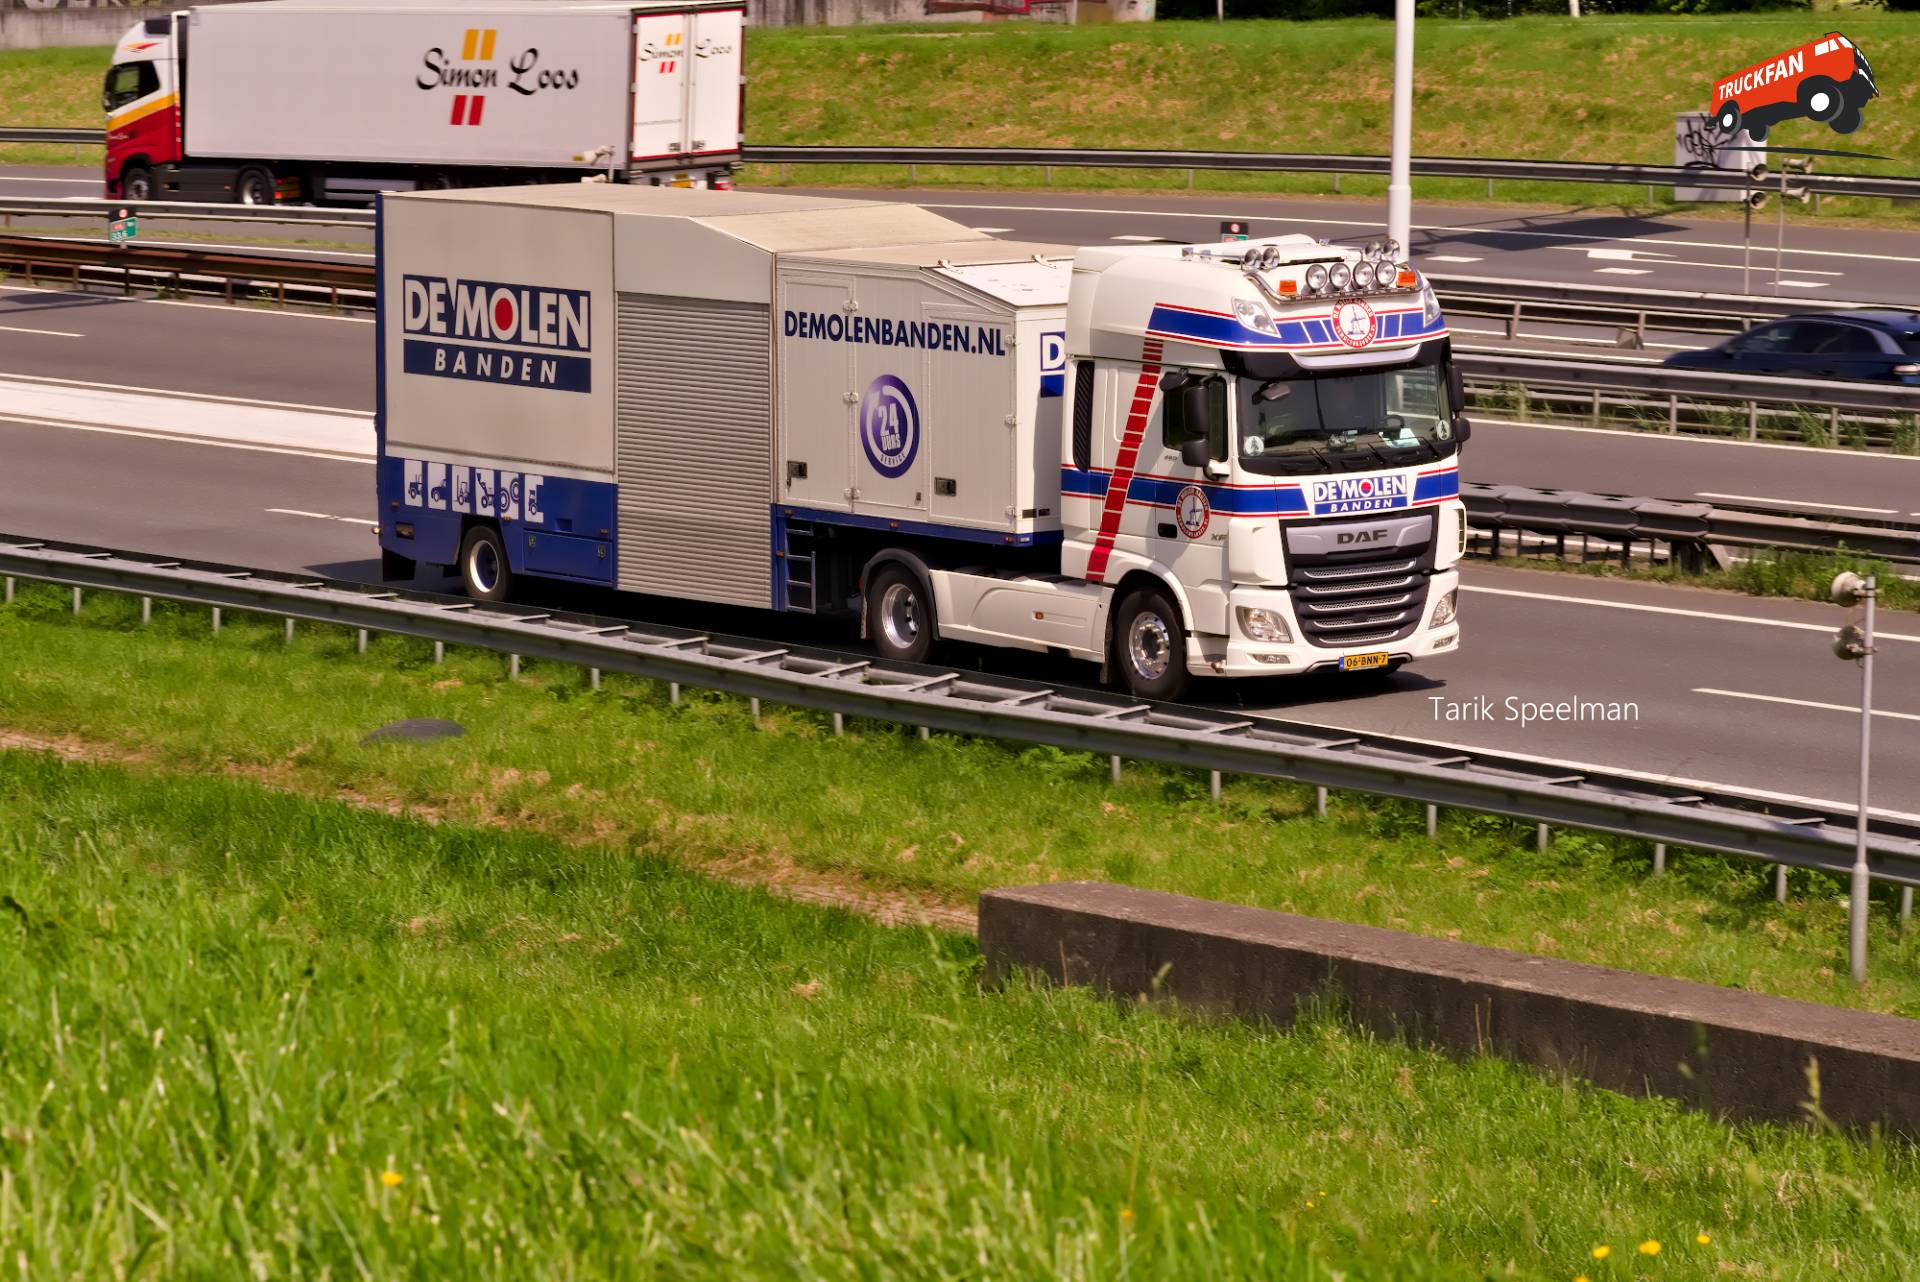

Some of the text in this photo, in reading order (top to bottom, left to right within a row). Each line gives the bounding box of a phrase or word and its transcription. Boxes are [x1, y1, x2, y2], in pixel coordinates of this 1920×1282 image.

[416, 48, 579, 95] Simon Loos
[404, 279, 589, 349] DE MOLEN
[784, 310, 1006, 356] DEMOLENBANDEN.NL
[434, 348, 557, 384] BANDEN
[878, 403, 899, 436] 24
[1315, 476, 1406, 501] DE MOLEN
[1330, 499, 1392, 513] BANDEN
[1336, 529, 1388, 544] DAF
